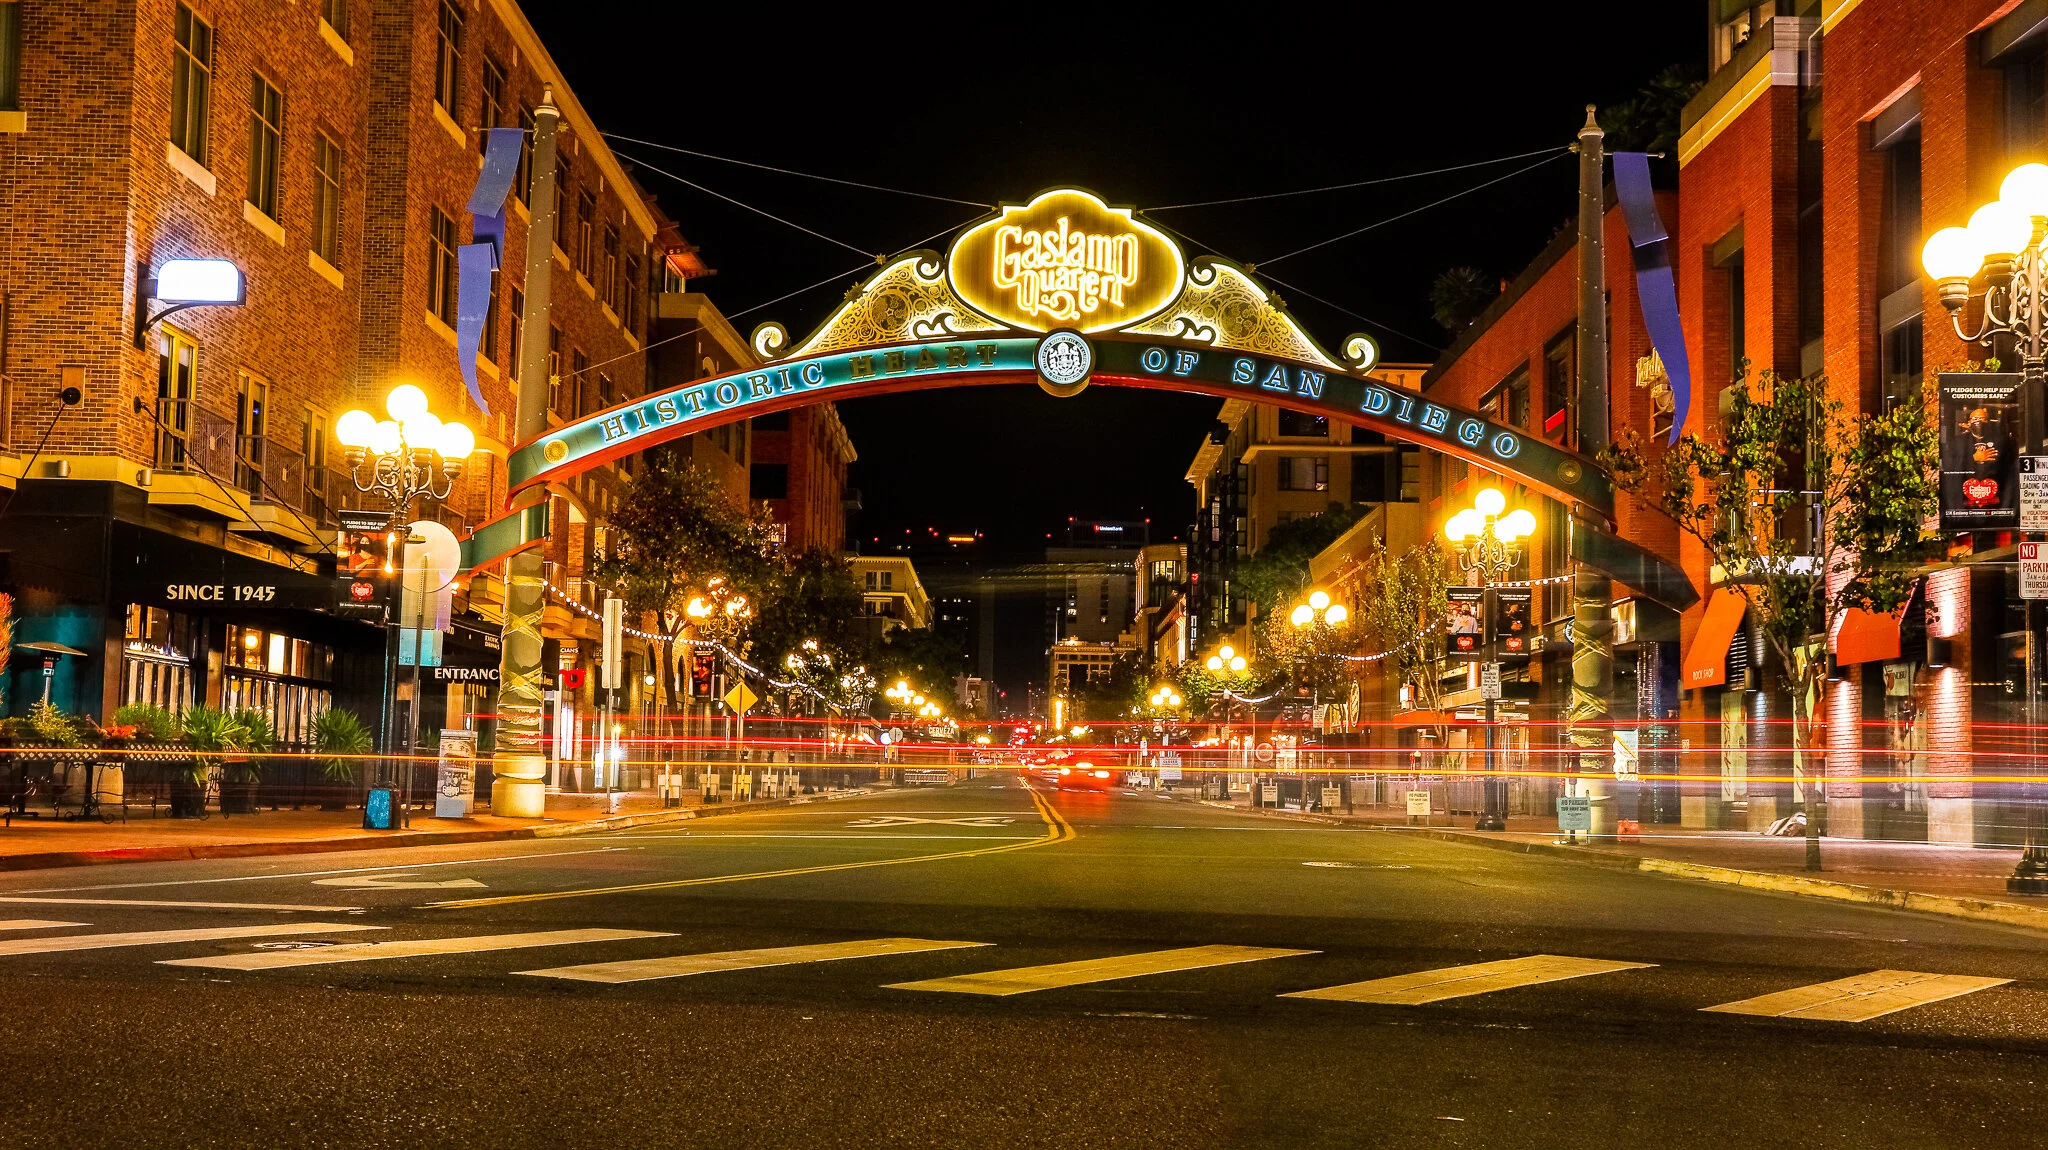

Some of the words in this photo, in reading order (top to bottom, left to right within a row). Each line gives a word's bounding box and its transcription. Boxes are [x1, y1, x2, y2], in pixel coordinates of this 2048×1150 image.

[993, 216, 1139, 288] Gaslamp
[1015, 264, 1125, 321] Quarter
[600, 362, 823, 442] HISTORIC
[849, 344, 997, 380] HEART
[1142, 347, 1199, 376] OF
[1232, 358, 1327, 399] SAN
[1361, 386, 1520, 459] DIEGO
[2023, 458, 2030, 472] 3
[2022, 545, 2035, 558] NO
[166, 584, 225, 601] SINCE
[232, 585, 276, 602] 1945
